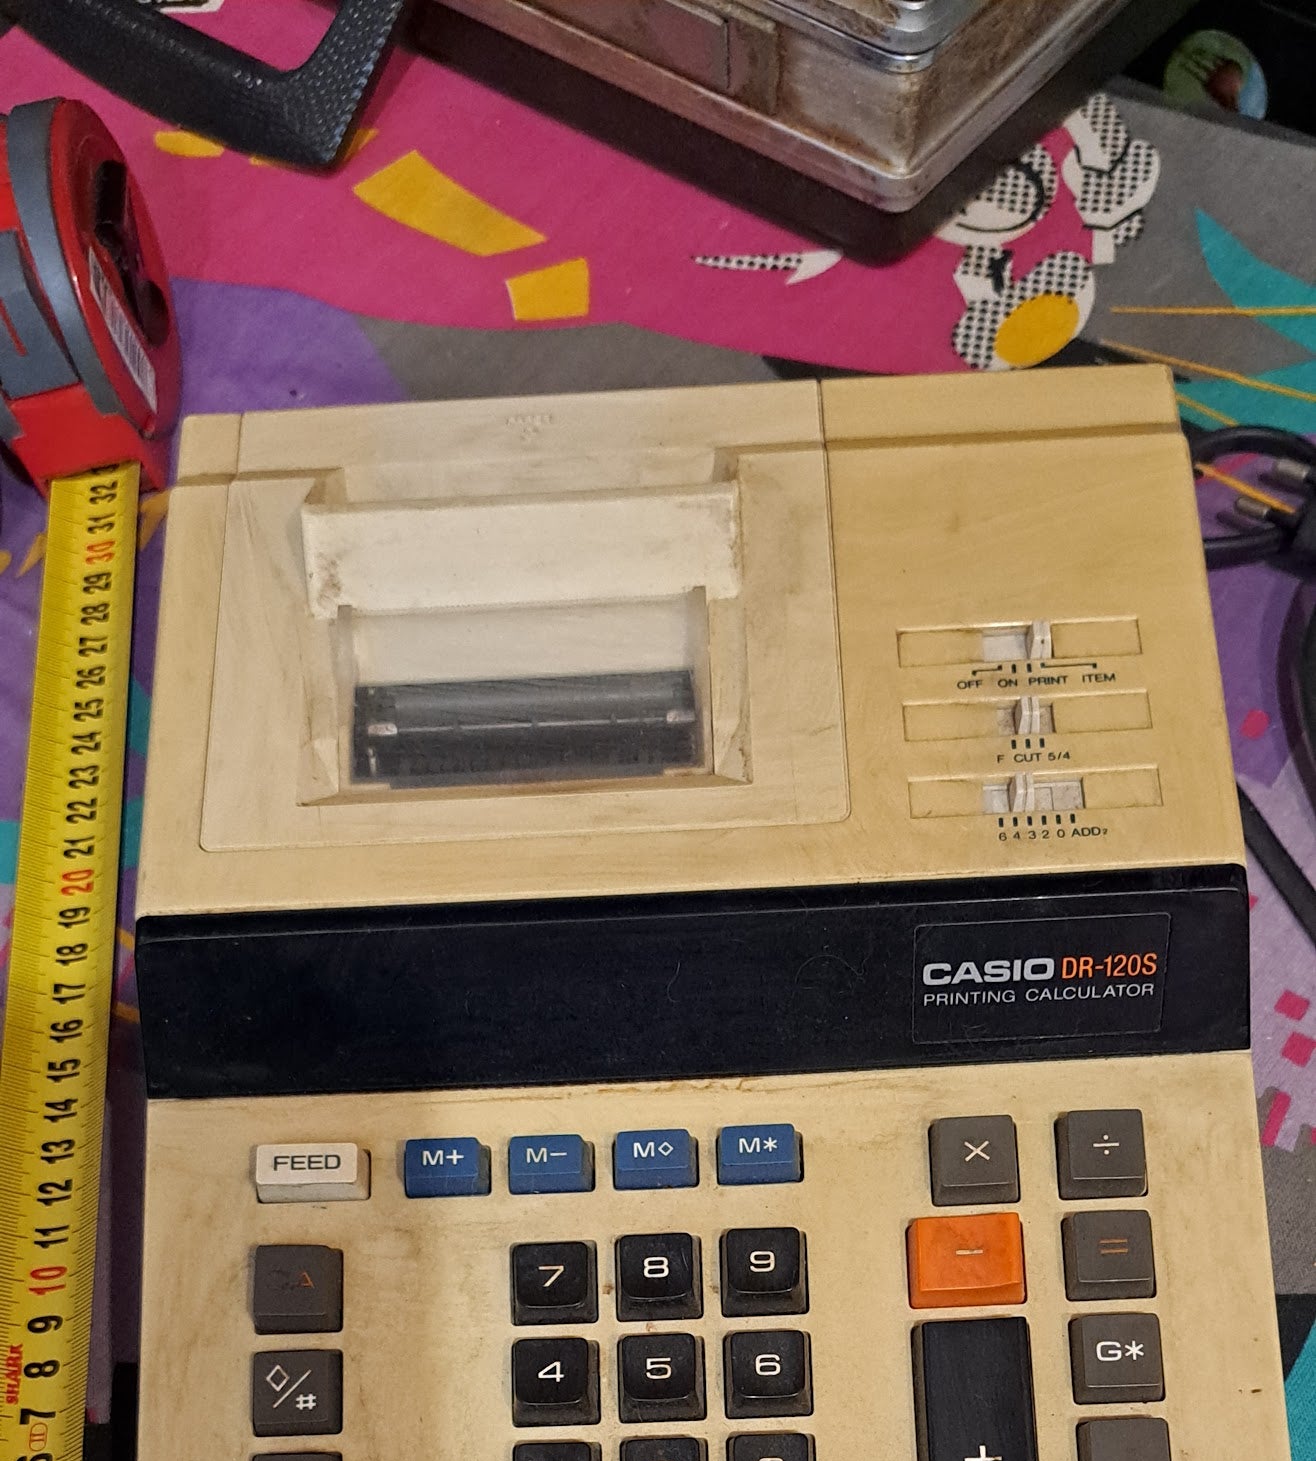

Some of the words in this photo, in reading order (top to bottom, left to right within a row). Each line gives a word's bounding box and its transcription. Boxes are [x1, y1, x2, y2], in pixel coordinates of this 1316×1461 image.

[89, 481, 118, 504] 32
[87, 513, 116, 534] 31
[86, 541, 116, 564] 30
[83, 571, 111, 594] 29
[80, 601, 110, 626] 28
[79, 636, 107, 658] 27
[76, 665, 106, 690] 26
[956, 679, 983, 690] OFF
[997, 678, 1018, 688] ON
[1028, 675, 1068, 686] PRINT
[1082, 672, 1116, 684] ITEM
[74, 698, 104, 722] 25
[71, 732, 101, 755] 24
[996, 754, 1005, 764] F
[1013, 752, 1042, 763] CUT
[1047, 751, 1071, 762] 5/4
[69, 765, 99, 789] 23
[66, 798, 97, 824] 22
[998, 832, 1008, 842] 6
[1013, 831, 1021, 841] 4
[1028, 830, 1037, 840] 3
[1041, 829, 1050, 840] 2
[64, 836, 95, 859] 21
[61, 869, 94, 896] 20
[58, 906, 90, 929] 19
[56, 943, 88, 966] 18
[922, 957, 1055, 987] CASIO
[1061, 952, 1158, 980] DR-120S
[52, 983, 86, 1005] 17
[923, 989, 1016, 1007] PRINTING
[1025, 983, 1155, 1002] CALCULATOR
[50, 1018, 83, 1043] 16
[46, 1058, 81, 1082] 15
[44, 1098, 78, 1123] 14
[41, 1139, 75, 1164] 13
[273, 1154, 341, 1172] FEED
[421, 1149, 464, 1167] M+
[37, 1178, 73, 1206] 12
[34, 1225, 69, 1248] 11
[643, 1256, 670, 1278] 8
[749, 1250, 776, 1273] 9
[28, 1266, 68, 1295] 10
[537, 1265, 565, 1287] 7
[27, 1315, 63, 1334] 9
[6, 1343, 23, 1405] SHARK
[23, 1359, 60, 1379] 8
[537, 1361, 565, 1383] 4
[645, 1357, 673, 1380] 5
[754, 1353, 781, 1376] 6
[19, 1408, 56, 1425] 7
